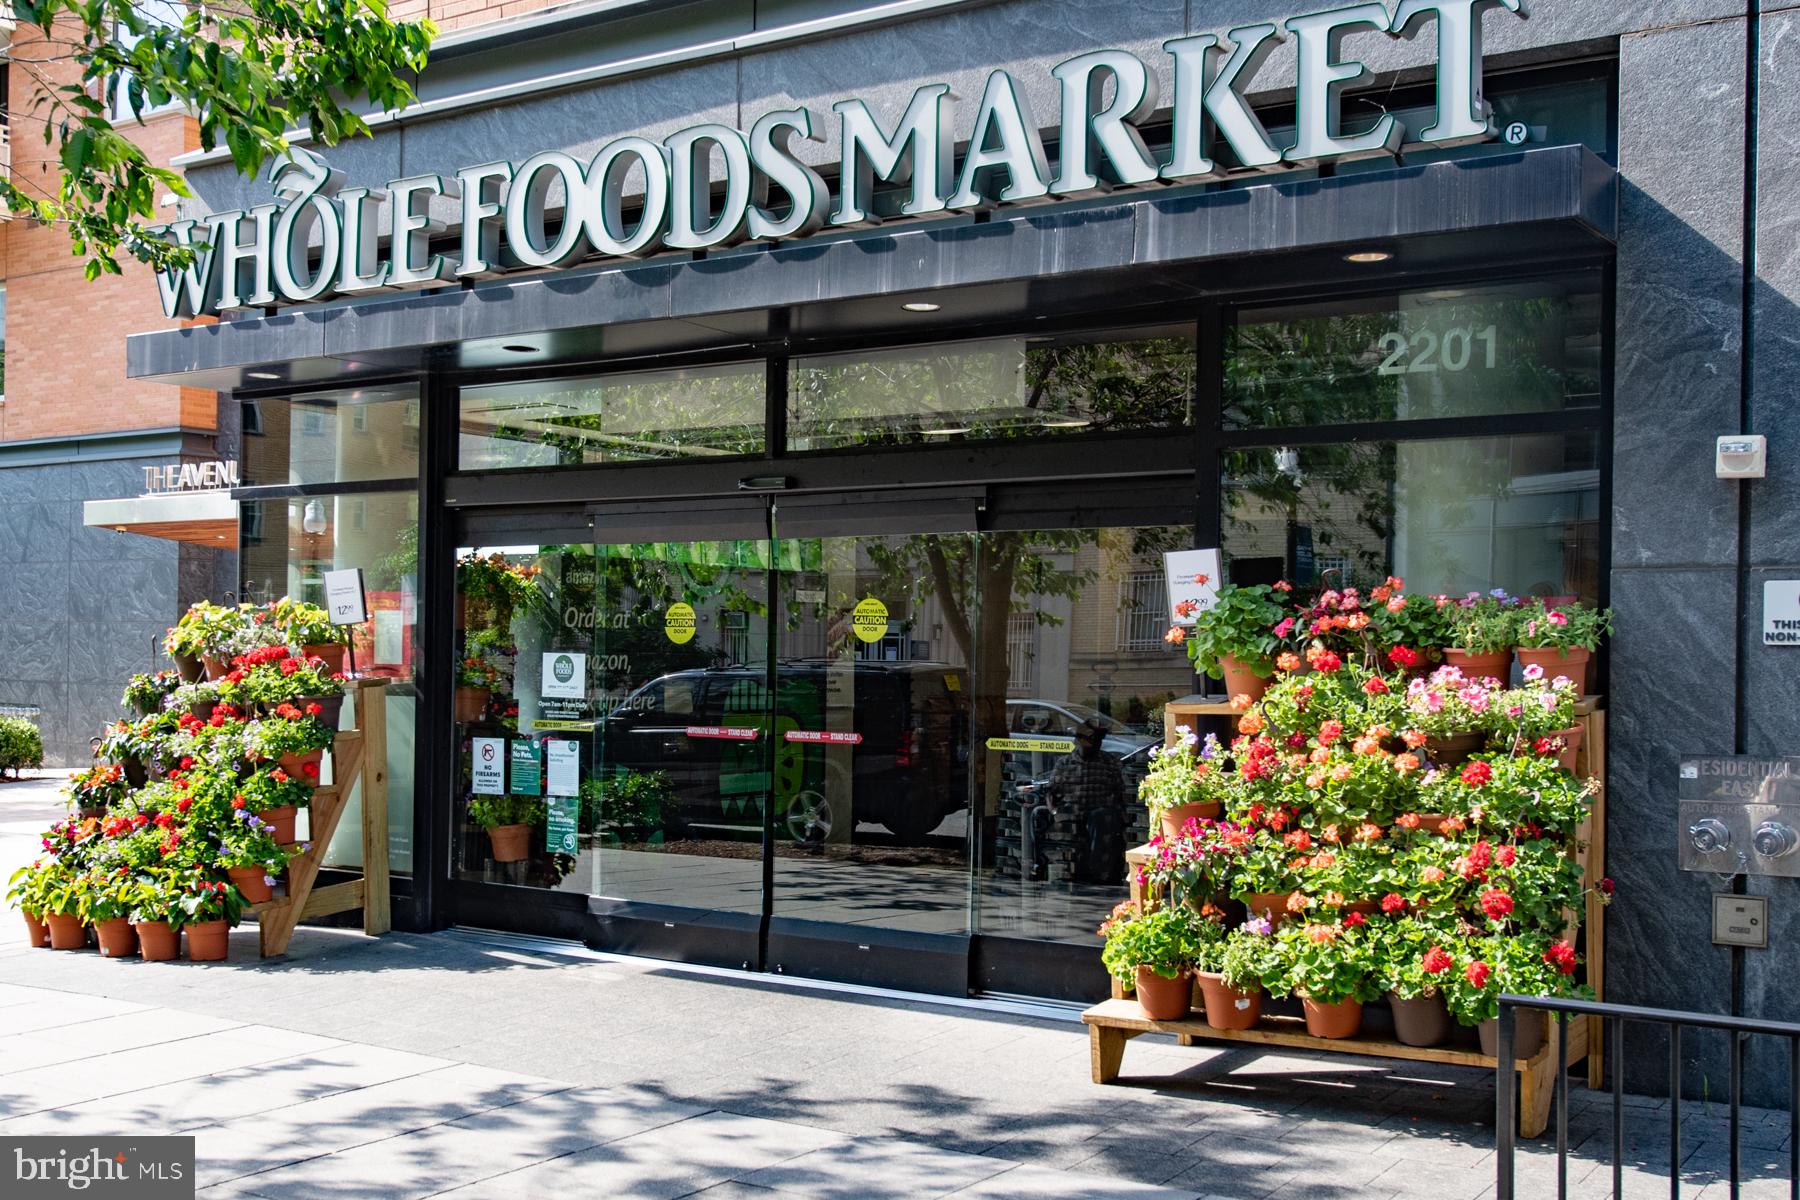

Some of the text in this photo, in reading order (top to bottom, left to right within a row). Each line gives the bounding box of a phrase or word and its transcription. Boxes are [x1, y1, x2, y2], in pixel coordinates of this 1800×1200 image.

[147, 146, 443, 319] WHOLE
[455, 106, 815, 276] FOODS
[830, 0, 1520, 225] MARKET
[1377, 325, 1497, 376] 2201
[141, 464, 180, 489] THE
[565, 606, 631, 629] Order at
[666, 619, 695, 627] CAUTION
[854, 616, 887, 625] CAUTION
[687, 727, 708, 735] AUTOMATIC
[740, 729, 753, 737] CLEAR
[786, 731, 858, 741] AUTOMATIC DOOR STAND CLEAR
[990, 740, 1016, 748] AUTOMATIC
[1040, 742, 1055, 750] STAND
[1055, 743, 1070, 751] CLEAR
